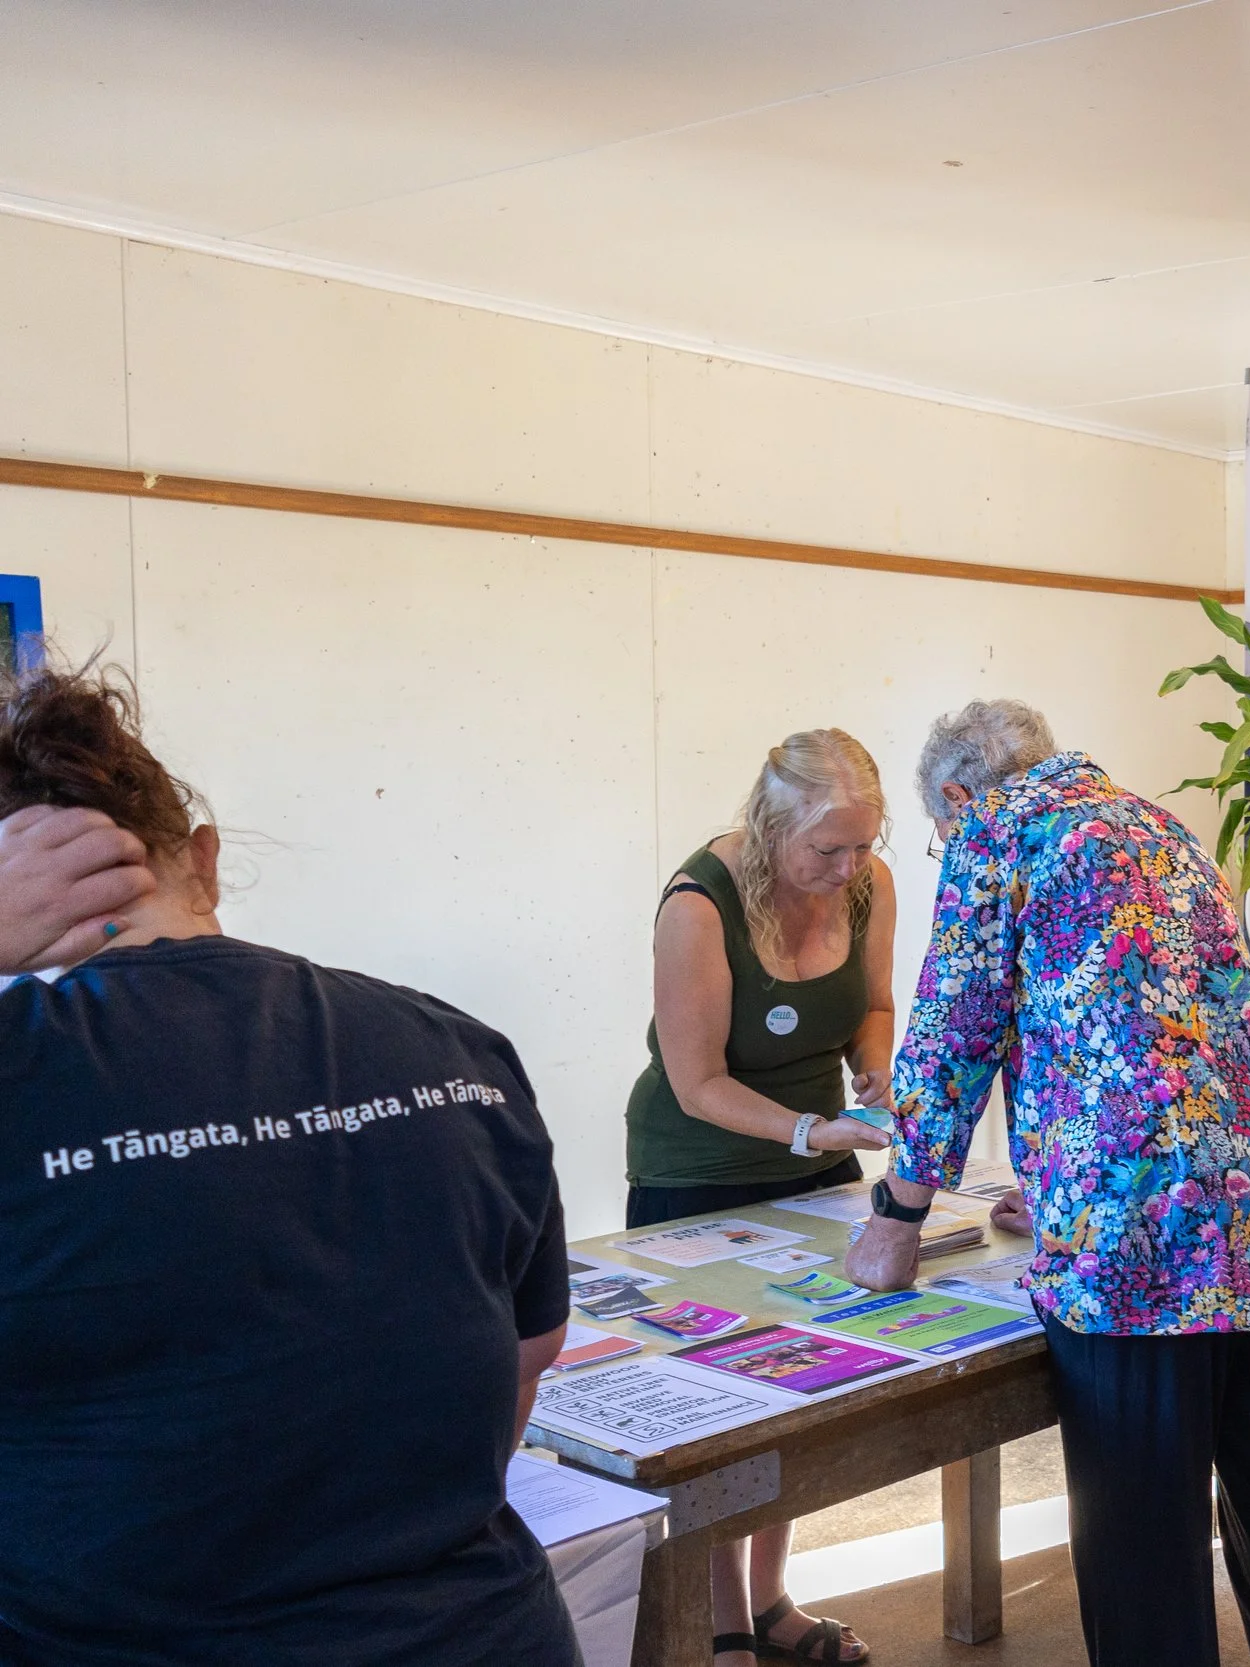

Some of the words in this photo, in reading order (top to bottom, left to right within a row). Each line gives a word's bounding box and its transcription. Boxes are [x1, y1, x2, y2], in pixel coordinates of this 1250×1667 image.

[43, 1147, 94, 1179] He
[102, 1129, 248, 1163] Tāngata,
[254, 1116, 291, 1142] He
[294, 1105, 411, 1133] Tāngata,
[412, 1086, 445, 1109] He
[603, 1383, 663, 1403] PLANTING
[619, 1390, 674, 1407] INVASIVE
[626, 1398, 662, 1410] WEED
[635, 1395, 693, 1413] REMOVAL
[647, 1397, 707, 1416] PREDATOR
[654, 1394, 730, 1418] ERADICATION
[677, 1400, 756, 1426] MAINTENANCE
[669, 1411, 706, 1423] TRAIL
